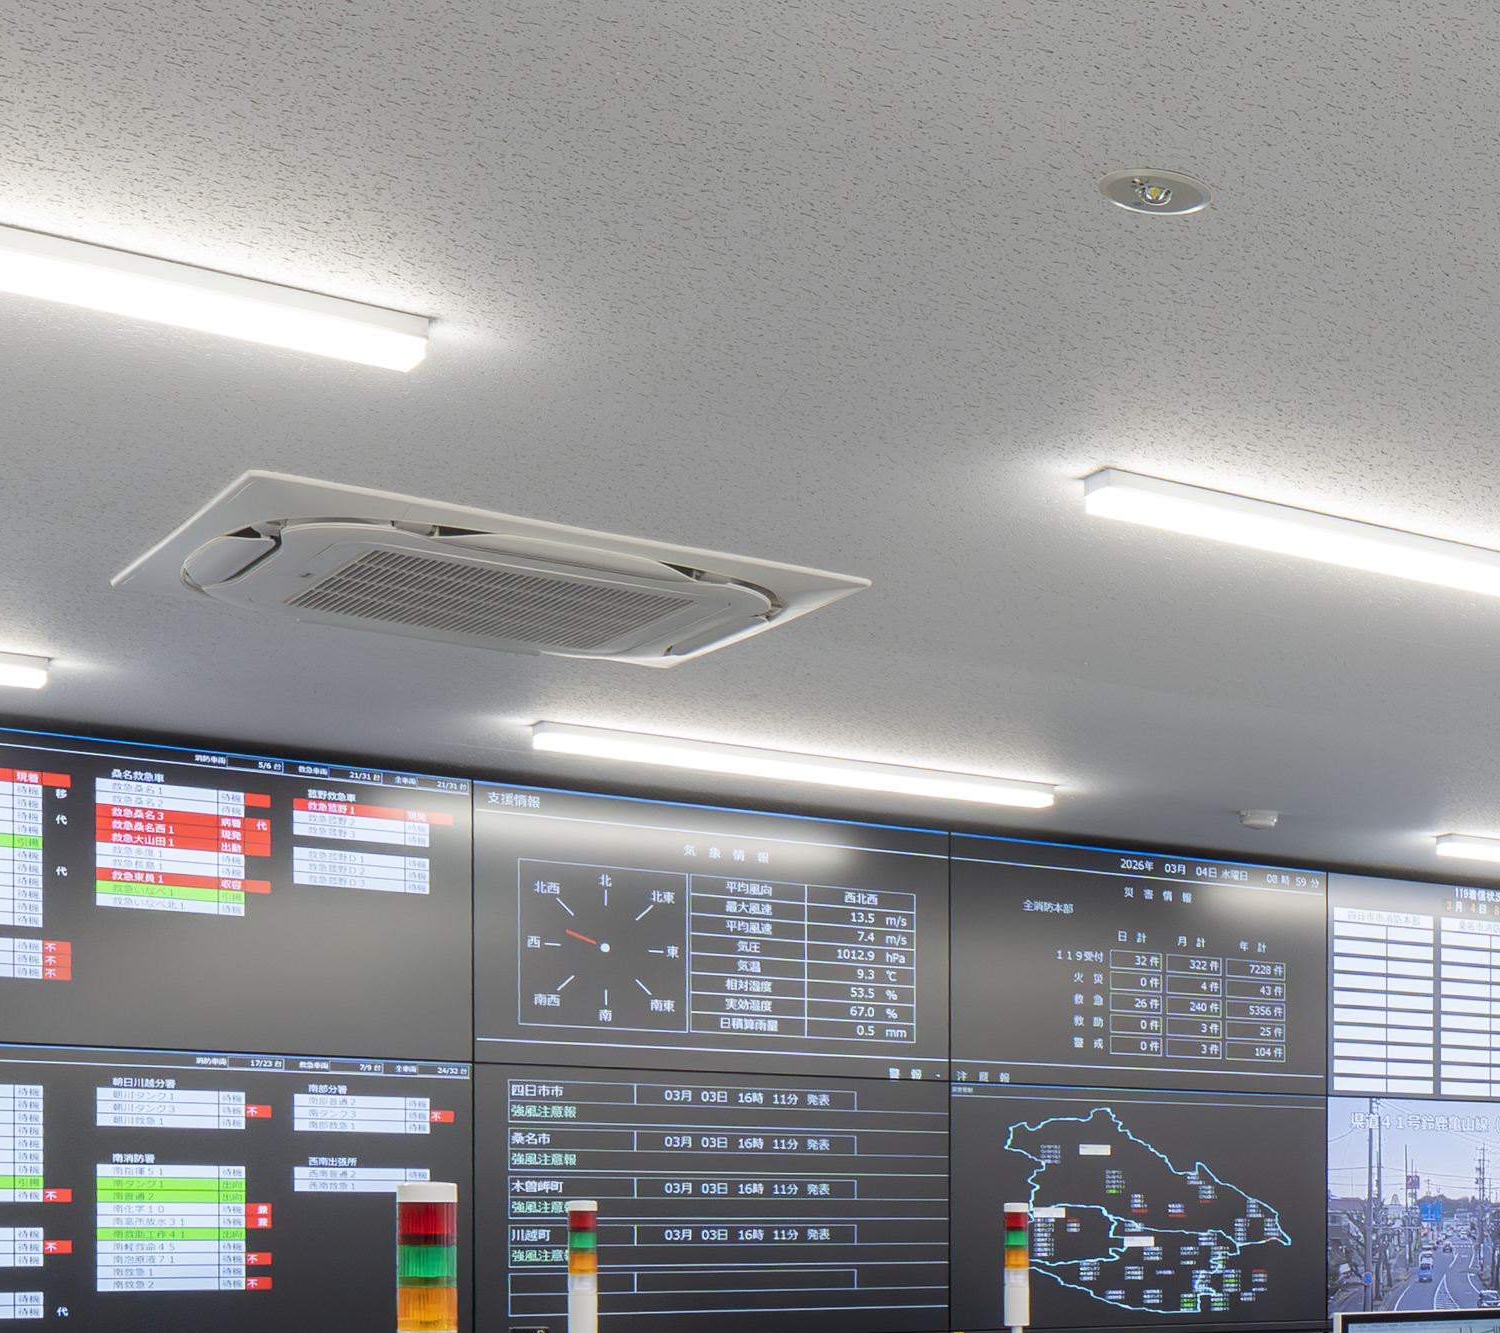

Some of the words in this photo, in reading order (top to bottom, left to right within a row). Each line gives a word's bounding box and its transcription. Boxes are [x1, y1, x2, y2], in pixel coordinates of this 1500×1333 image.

[111, 768, 164, 782] 桑名救急車
[488, 791, 540, 808] 支援情報
[600, 874, 612, 886] 北
[533, 881, 560, 894] 北西
[725, 882, 773, 896] 平均風向
[844, 892, 878, 905] 西北西
[651, 890, 675, 904] 北東
[1023, 900, 1074, 914] 全消防本部
[726, 902, 773, 915] 最大風速
[851, 913, 875, 923] 13.5
[886, 915, 907, 927] m/s
[725, 921, 773, 935] 平均風速
[857, 931, 875, 941] 7.4
[886, 934, 907, 945] m/s
[527, 936, 540, 948] 西
[666, 946, 679, 958] 東
[737, 941, 760, 953] 気圧
[837, 950, 875, 960] 1012.9
[886, 952, 905, 964] hPa
[737, 960, 761, 973] 気温
[857, 969, 875, 979] 9.3
[725, 979, 772, 993] 相対湿度
[851, 988, 875, 998] 53.5
[886, 990, 897, 1000] %
[534, 994, 560, 1007] 南西
[650, 999, 675, 1012] 南東
[600, 1009, 612, 1022] 南
[725, 998, 772, 1012] 実効湿度
[850, 1006, 875, 1017] 67.0
[886, 1009, 897, 1019] %
[720, 1018, 778, 1032] 日積算雨量
[857, 1025, 875, 1036] 0.5
[886, 1028, 906, 1038] mm
[112, 1077, 176, 1089] 朝日川越分署
[511, 1084, 563, 1098] 四日市市
[665, 1090, 692, 1102] 03月
[701, 1090, 728, 1102] 03日
[738, 1092, 764, 1104] 16時
[773, 1093, 799, 1105] 11分
[808, 1094, 830, 1106] 発表
[511, 1105, 576, 1119] 強風注意報
[511, 1133, 551, 1145] 桑名市
[112, 1153, 155, 1164] 南消防署
[511, 1153, 577, 1166] 強風注意報
[511, 1181, 564, 1194] 木曽岬町
[511, 1229, 551, 1242] 川越町
